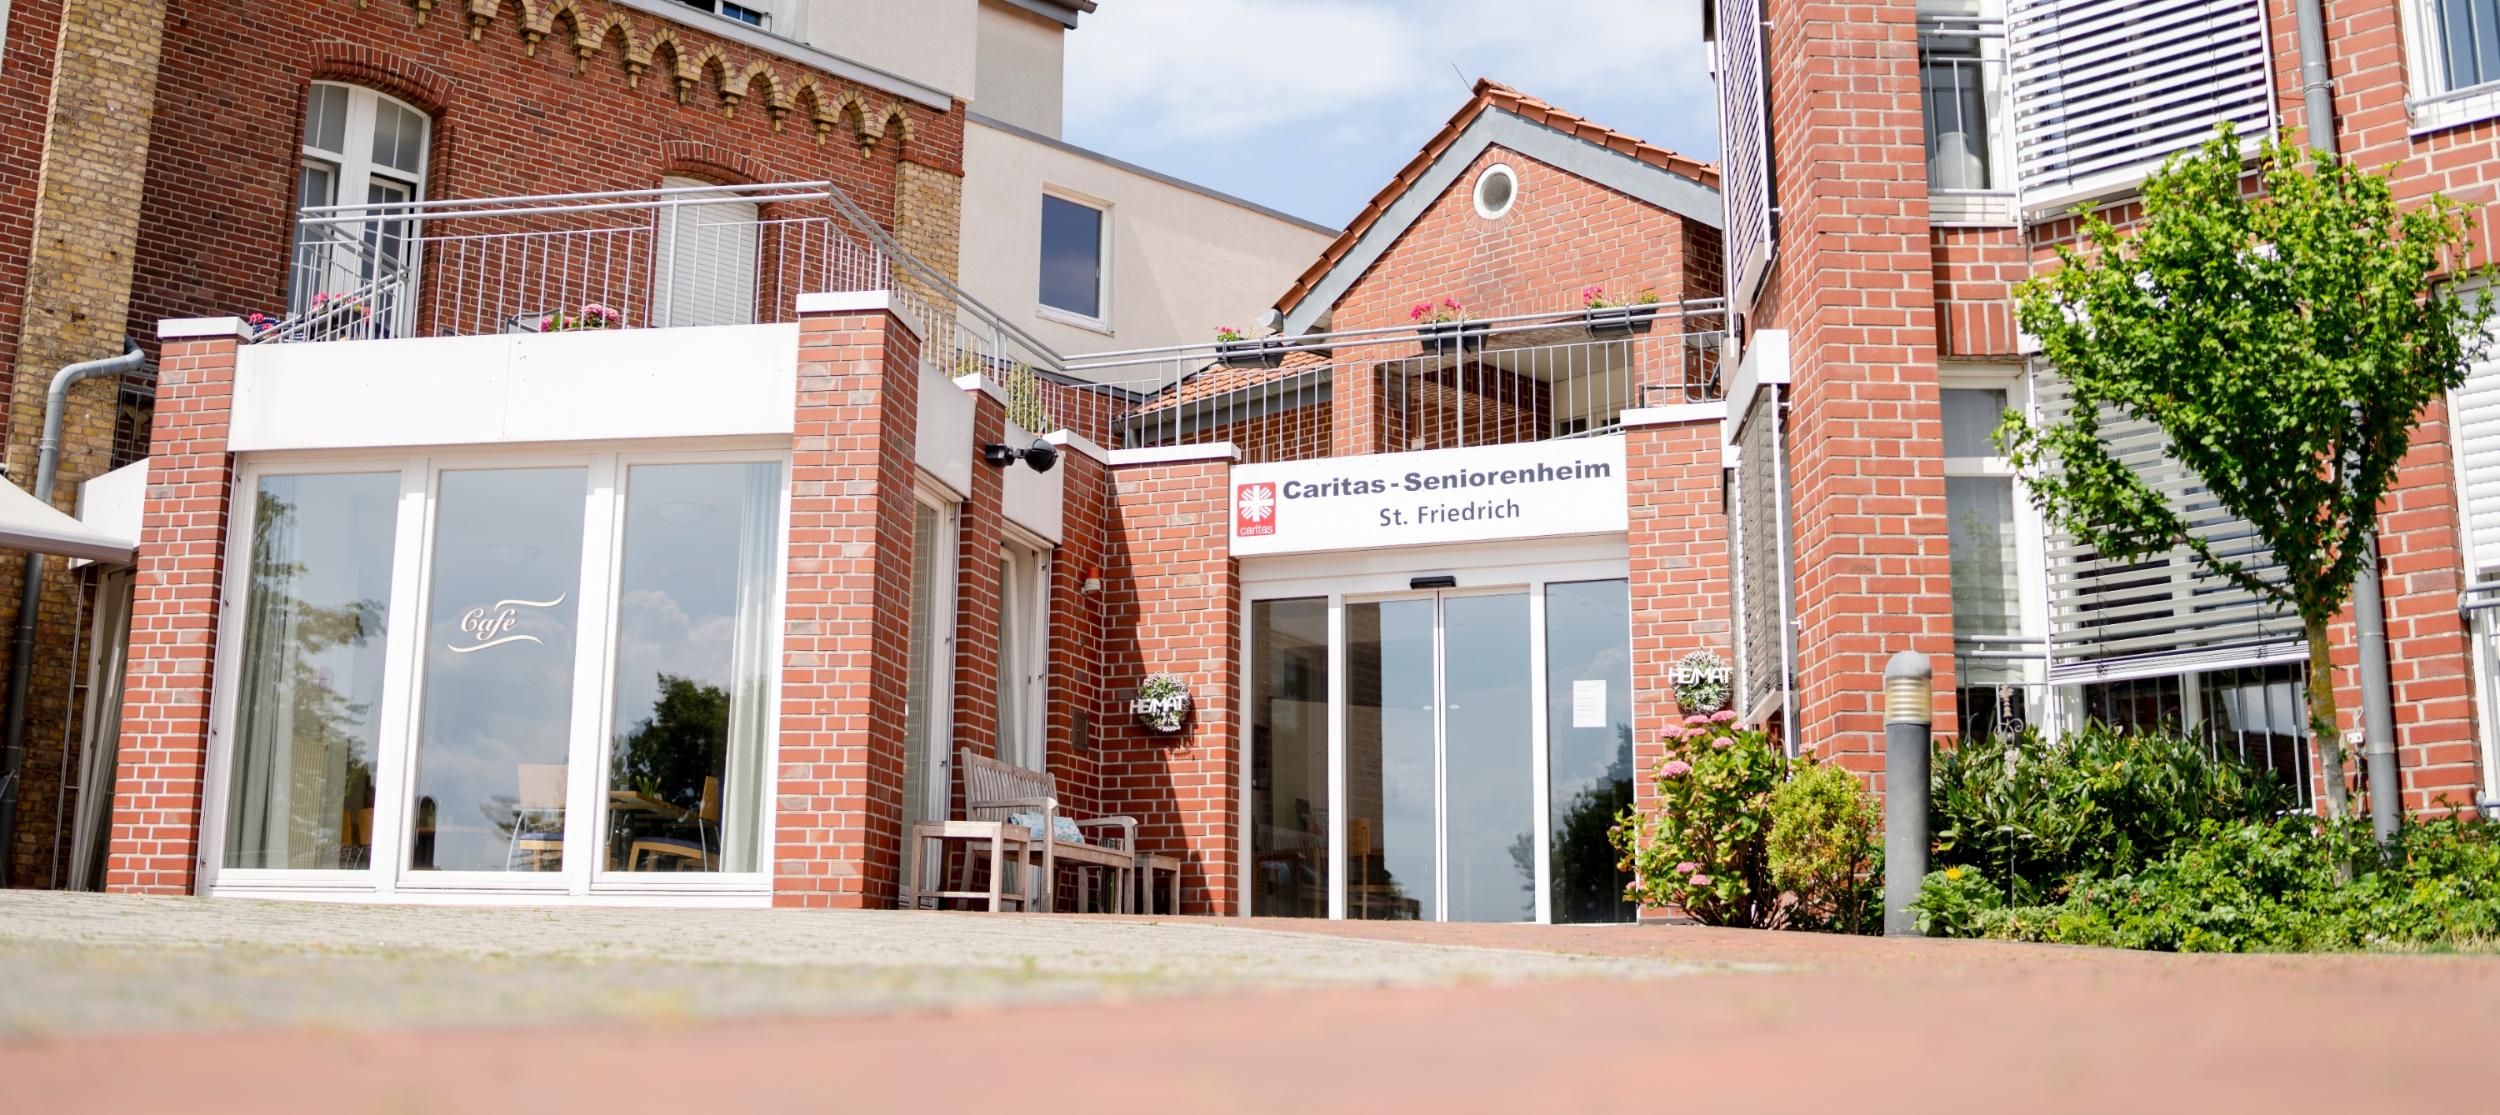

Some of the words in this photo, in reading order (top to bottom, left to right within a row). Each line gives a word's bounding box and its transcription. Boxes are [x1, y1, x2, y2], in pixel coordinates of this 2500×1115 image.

[1379, 507, 1408, 527] St.
[1417, 499, 1520, 525] Friedrich
[1239, 524, 1274, 536] caritas
